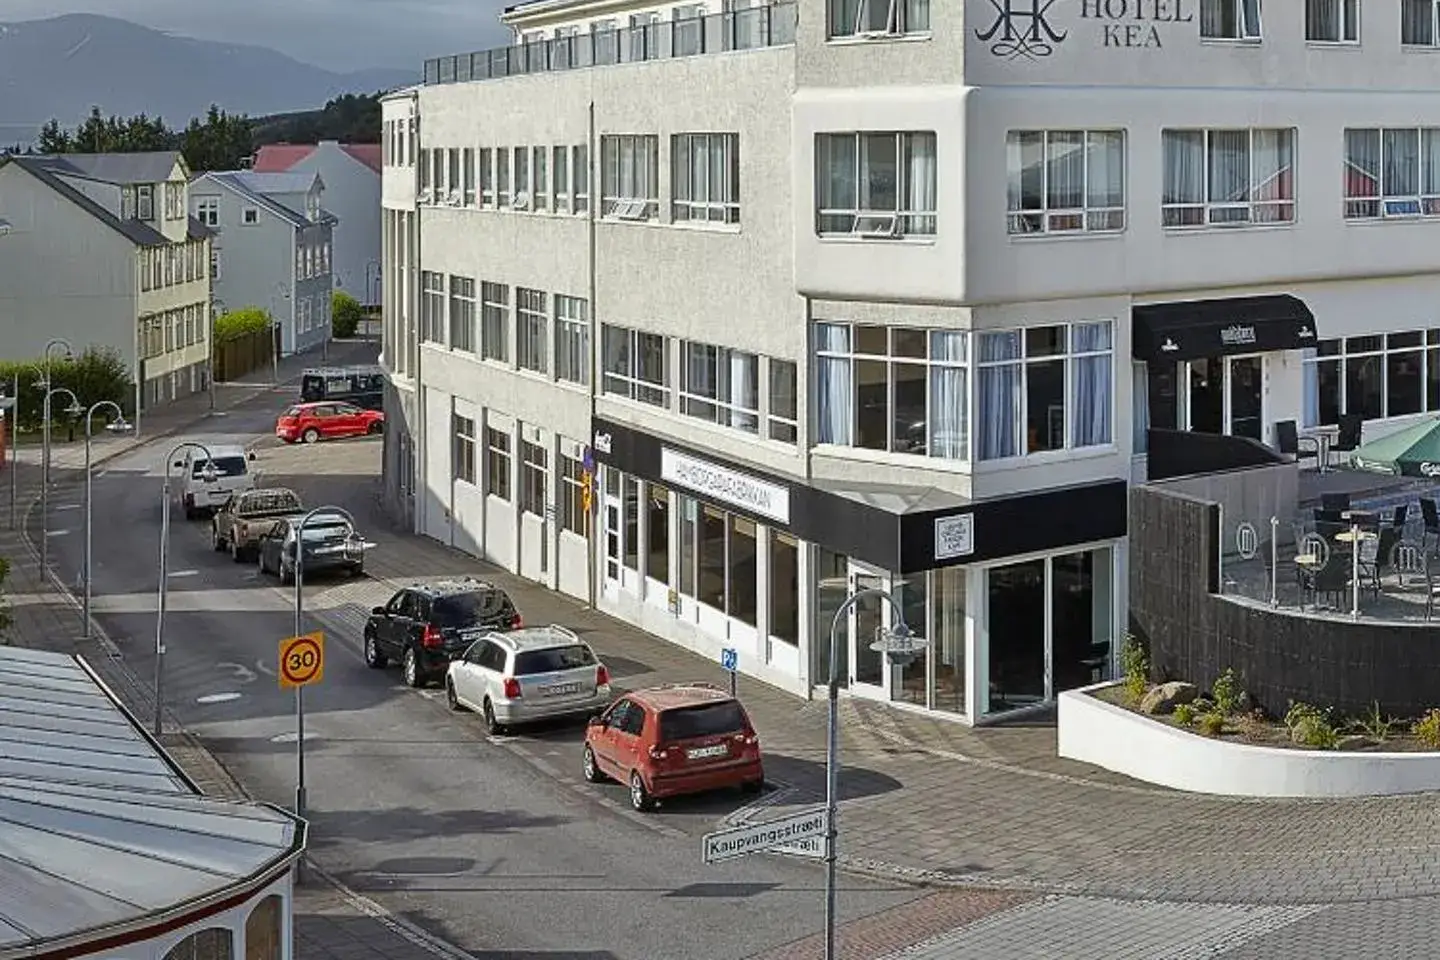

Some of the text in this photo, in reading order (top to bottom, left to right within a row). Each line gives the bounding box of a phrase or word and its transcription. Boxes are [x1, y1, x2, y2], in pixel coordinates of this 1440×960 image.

[1102, 24, 1163, 49] KEA
[290, 650, 314, 671] 30
[709, 816, 822, 855] Kaupvangsstræti
